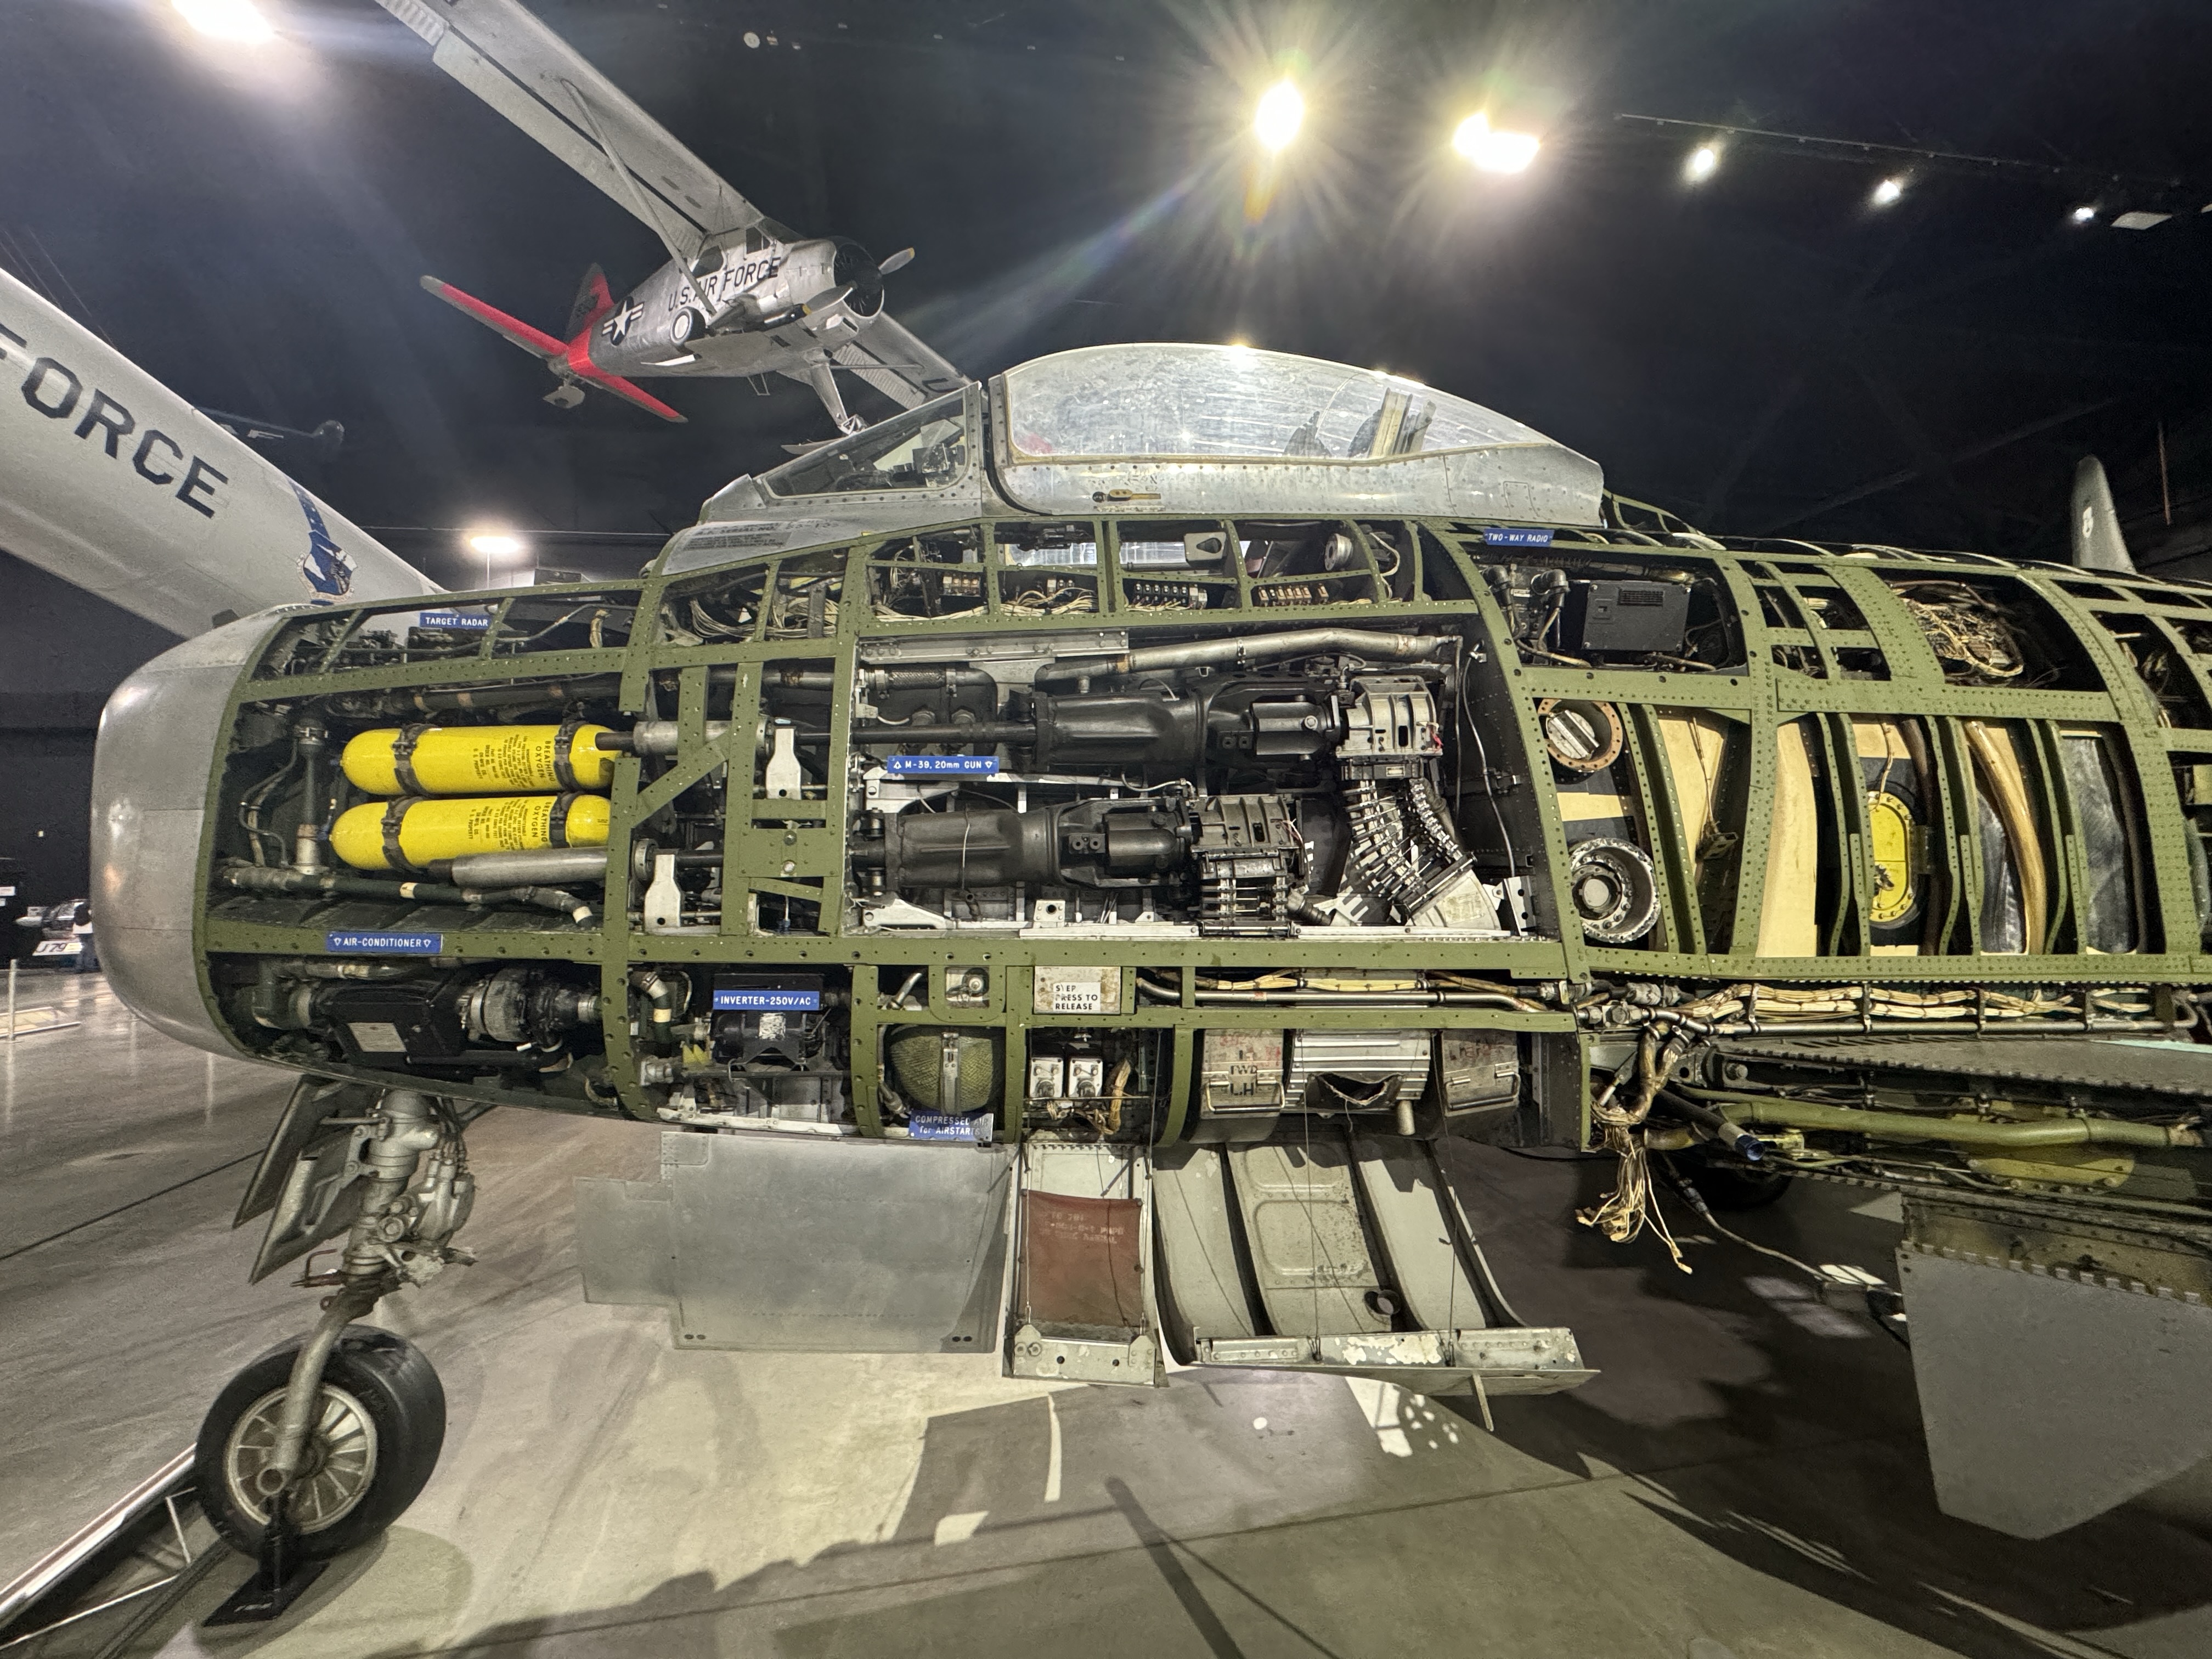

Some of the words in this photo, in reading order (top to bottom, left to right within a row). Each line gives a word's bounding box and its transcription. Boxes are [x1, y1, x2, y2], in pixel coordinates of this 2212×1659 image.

[668, 286, 691, 312] U.S.
[723, 257, 781, 291] FORCE
[1527, 534, 1548, 543] RADIO
[425, 617, 458, 625] TARGET
[461, 618, 488, 627] RADAR
[535, 746, 546, 778] OXYGEN
[544, 741, 555, 781] BREATHING
[935, 760, 960, 769] 20mm
[964, 760, 982, 769] GUN
[531, 805, 541, 838] OXYGEN
[540, 802, 552, 842] BREATHING
[343, 938, 421, 947] AIR-CONDITIONER
[720, 996, 811, 1005] INVERTER-250V/AC
[915, 1115, 970, 1125] COMPRESSED
[973, 1118, 987, 1126] AIR
[919, 1125, 932, 1133] for
[935, 1126, 980, 1136] AIRSTARTS
